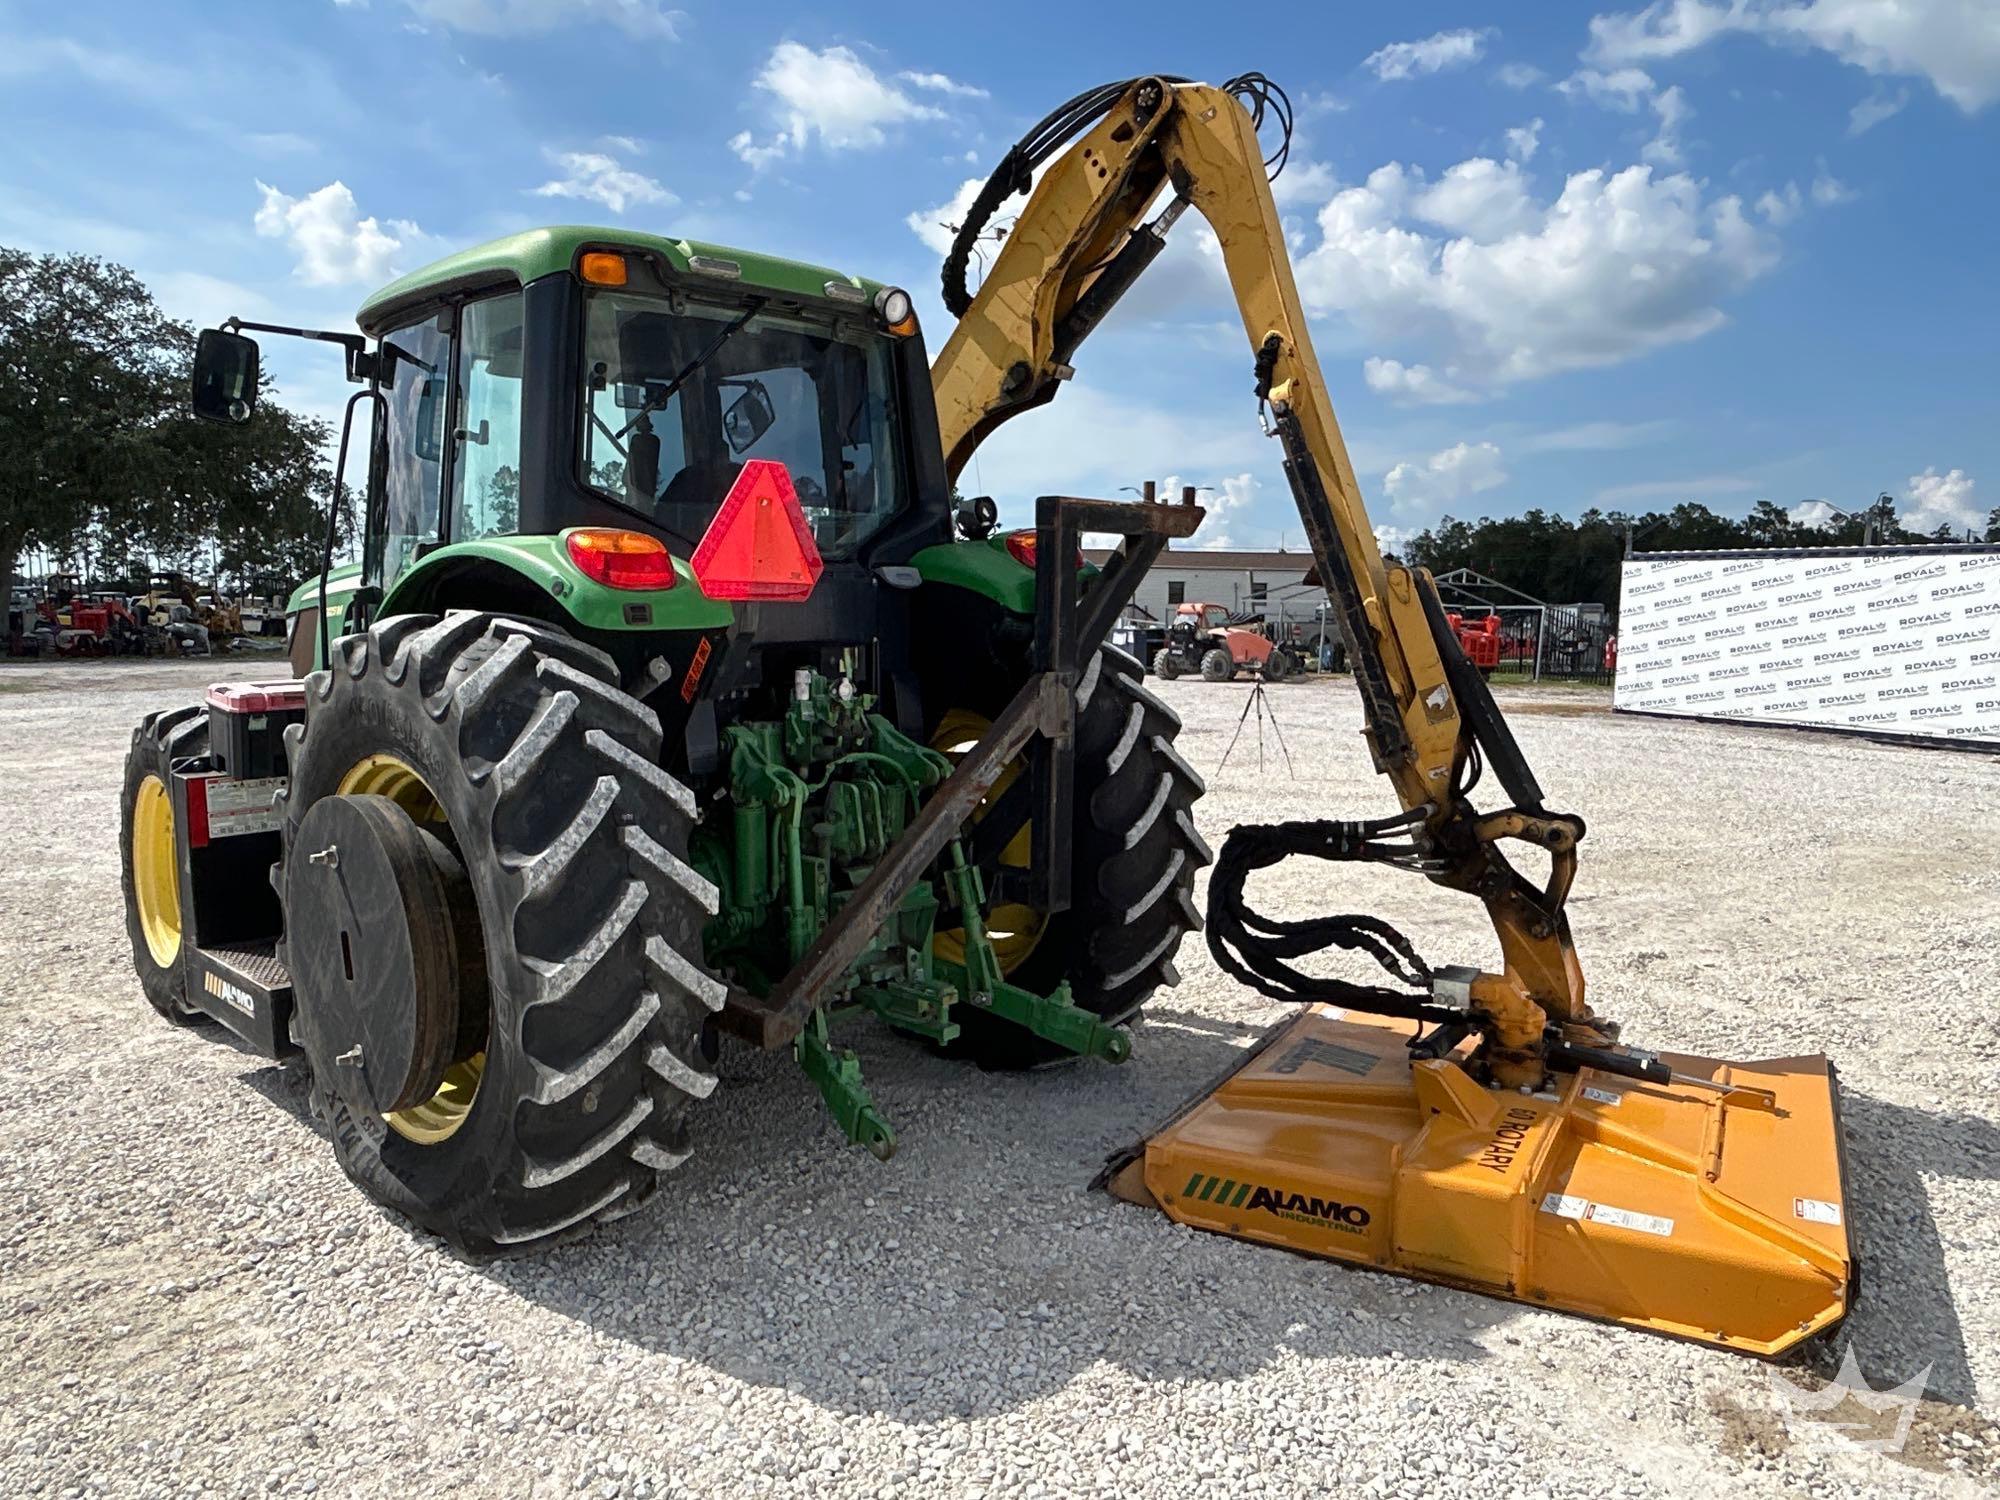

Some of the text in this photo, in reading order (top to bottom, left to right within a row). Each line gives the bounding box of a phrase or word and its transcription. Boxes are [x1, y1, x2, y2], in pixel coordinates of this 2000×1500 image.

[1722, 562, 1754, 572] ROYAL
[1805, 565, 1841, 575] ROYAL
[1894, 568, 1935, 580] ROYAL
[1751, 576, 1785, 586] ROYAL
[1834, 581, 1872, 591] ROYAL
[1931, 585, 1974, 596] ROYAL
[1702, 588, 1733, 597] ROYAL
[1778, 592, 1813, 602] ROYAL
[1868, 597, 1907, 607] ROYAL
[1726, 603, 1759, 612] ROYAL
[1965, 604, 2000, 614] ROYA
[1809, 608, 1846, 618] ROYAL
[1755, 618, 1789, 628] ROYAL
[1899, 614, 1940, 624] ROYAL
[1705, 628, 1737, 636] ROYAL
[1838, 625, 1876, 634] ROYAL
[1782, 635, 1817, 644] ROYAL
[1936, 632, 1979, 642] ROYAL
[1730, 644, 1763, 652] ROYAL
[1873, 642, 1912, 651] ROYAL
[1814, 651, 1850, 660] ROYAL
[1970, 651, 2000, 660] ROY
[1759, 660, 1793, 668] ROYAL
[1904, 660, 1946, 669] ROYAL
[1709, 668, 1740, 676] ROYAL
[1843, 669, 1882, 678] ROYAL
[1787, 678, 1822, 686] ROYAL
[1941, 679, 1985, 688] ROYAL
[1735, 685, 1767, 693] ROYAL
[1878, 687, 1918, 696] ROYAL
[1819, 695, 1856, 703] ROYAL
[1764, 702, 1798, 710] ROYAL
[1910, 706, 1951, 715] ROYAL
[1848, 714, 1887, 722] ROYAL
[1947, 726, 1990, 734] ROYAL
[1477, 1121, 1530, 1174] ROTARY
[1245, 1186, 1370, 1227] ALAMO
[1279, 1210, 1364, 1234] INDUSTRIAL
